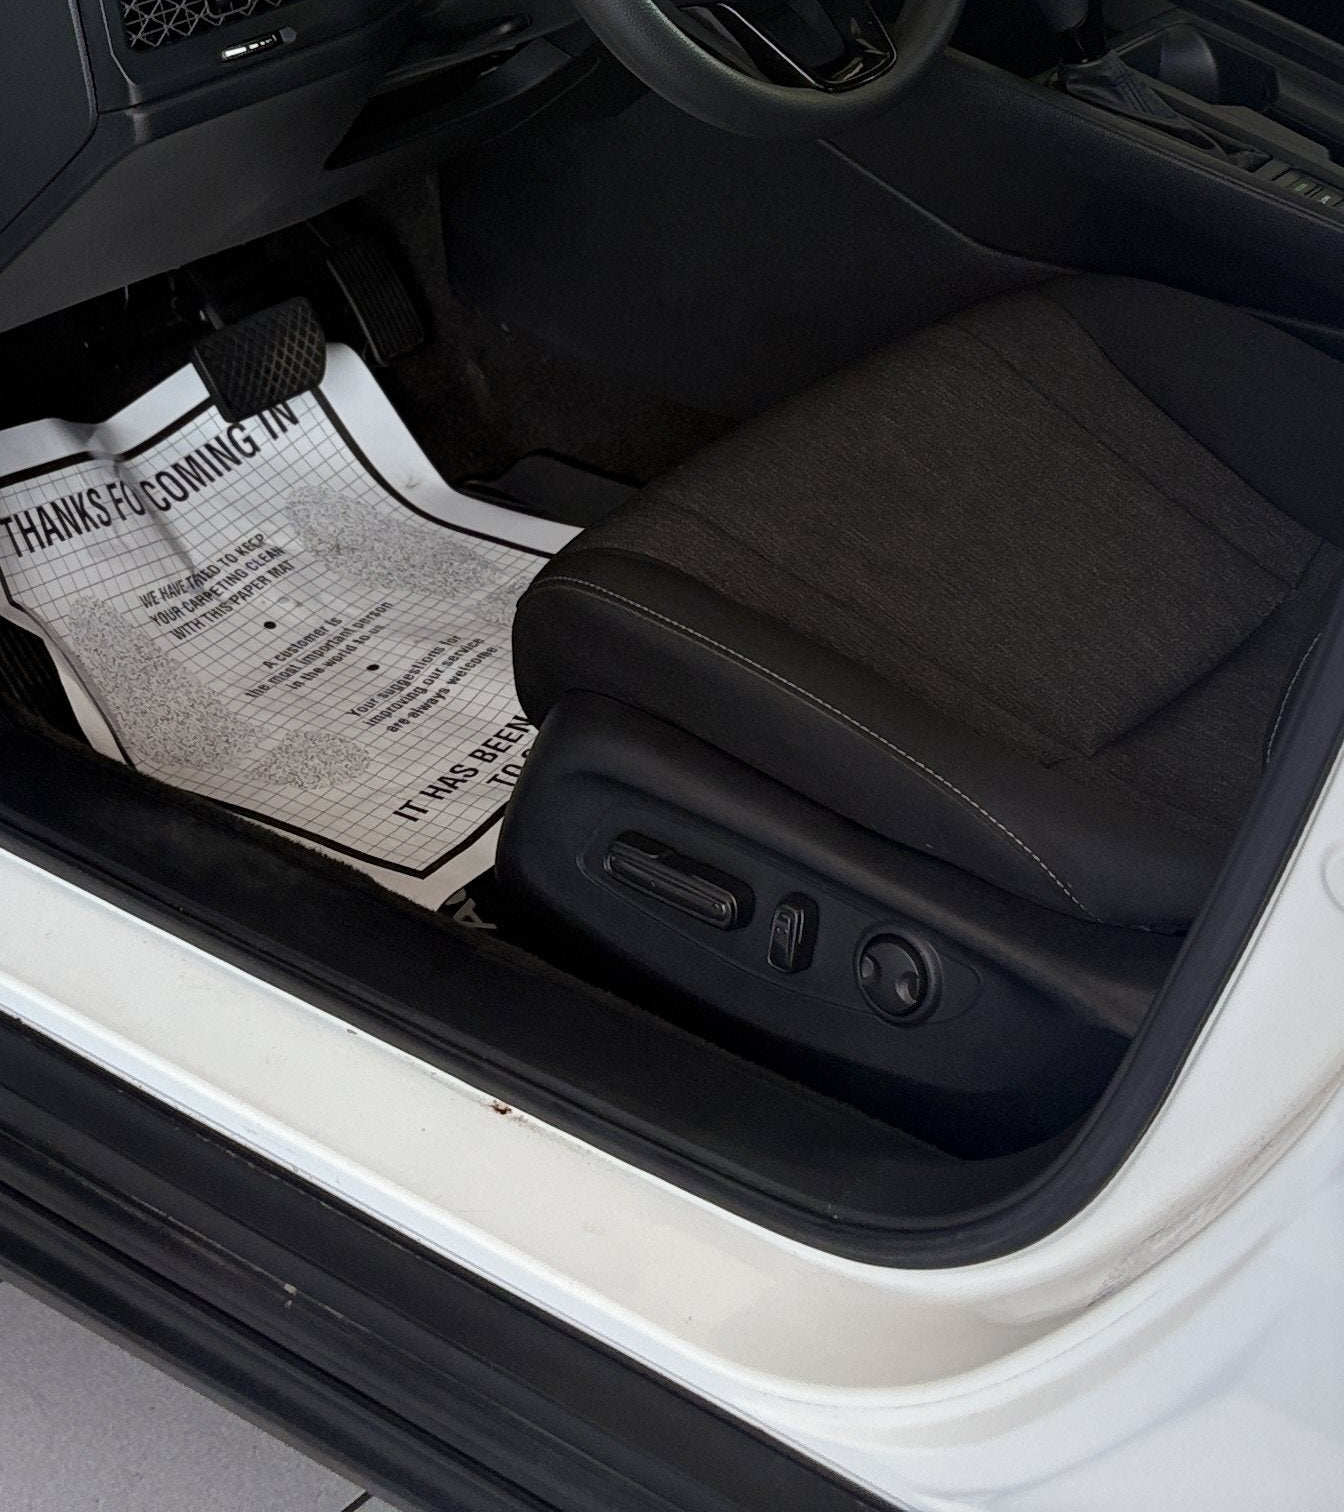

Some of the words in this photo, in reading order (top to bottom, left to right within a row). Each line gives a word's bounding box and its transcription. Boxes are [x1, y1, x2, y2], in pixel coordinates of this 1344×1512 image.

[0, 488, 112, 557] THANKS
[108, 480, 146, 520] FO
[140, 422, 261, 512] COMING
[257, 400, 299, 440] IN
[139, 591, 160, 609] WE
[158, 579, 188, 601] HAVE
[217, 553, 238, 567] TO
[235, 533, 265, 557] KEEP
[150, 605, 186, 627] YOUR
[181, 568, 248, 613] CARPETING
[245, 546, 286, 571] CLEAN
[169, 618, 206, 640] WITH
[200, 601, 234, 623] THIS
[228, 575, 272, 605] PAPER
[266, 559, 295, 578] MAT
[244, 683, 270, 698] the
[268, 663, 302, 685] most
[295, 627, 356, 666] important
[352, 601, 394, 629] person
[262, 660, 279, 669] A
[273, 625, 330, 662] customer
[324, 617, 343, 627] is
[285, 679, 306, 691] in
[301, 666, 325, 681] the
[322, 644, 358, 668] world
[352, 634, 371, 645] to
[346, 697, 380, 717] Your
[377, 646, 446, 699] suggestions
[439, 635, 462, 646] for
[362, 686, 429, 727] improving
[422, 667, 445, 686] our
[442, 638, 484, 668] service
[387, 717, 411, 733] are
[407, 687, 451, 719] always
[392, 799, 429, 822] IT
[419, 763, 480, 800] HAS
[468, 714, 532, 763] BEEN
